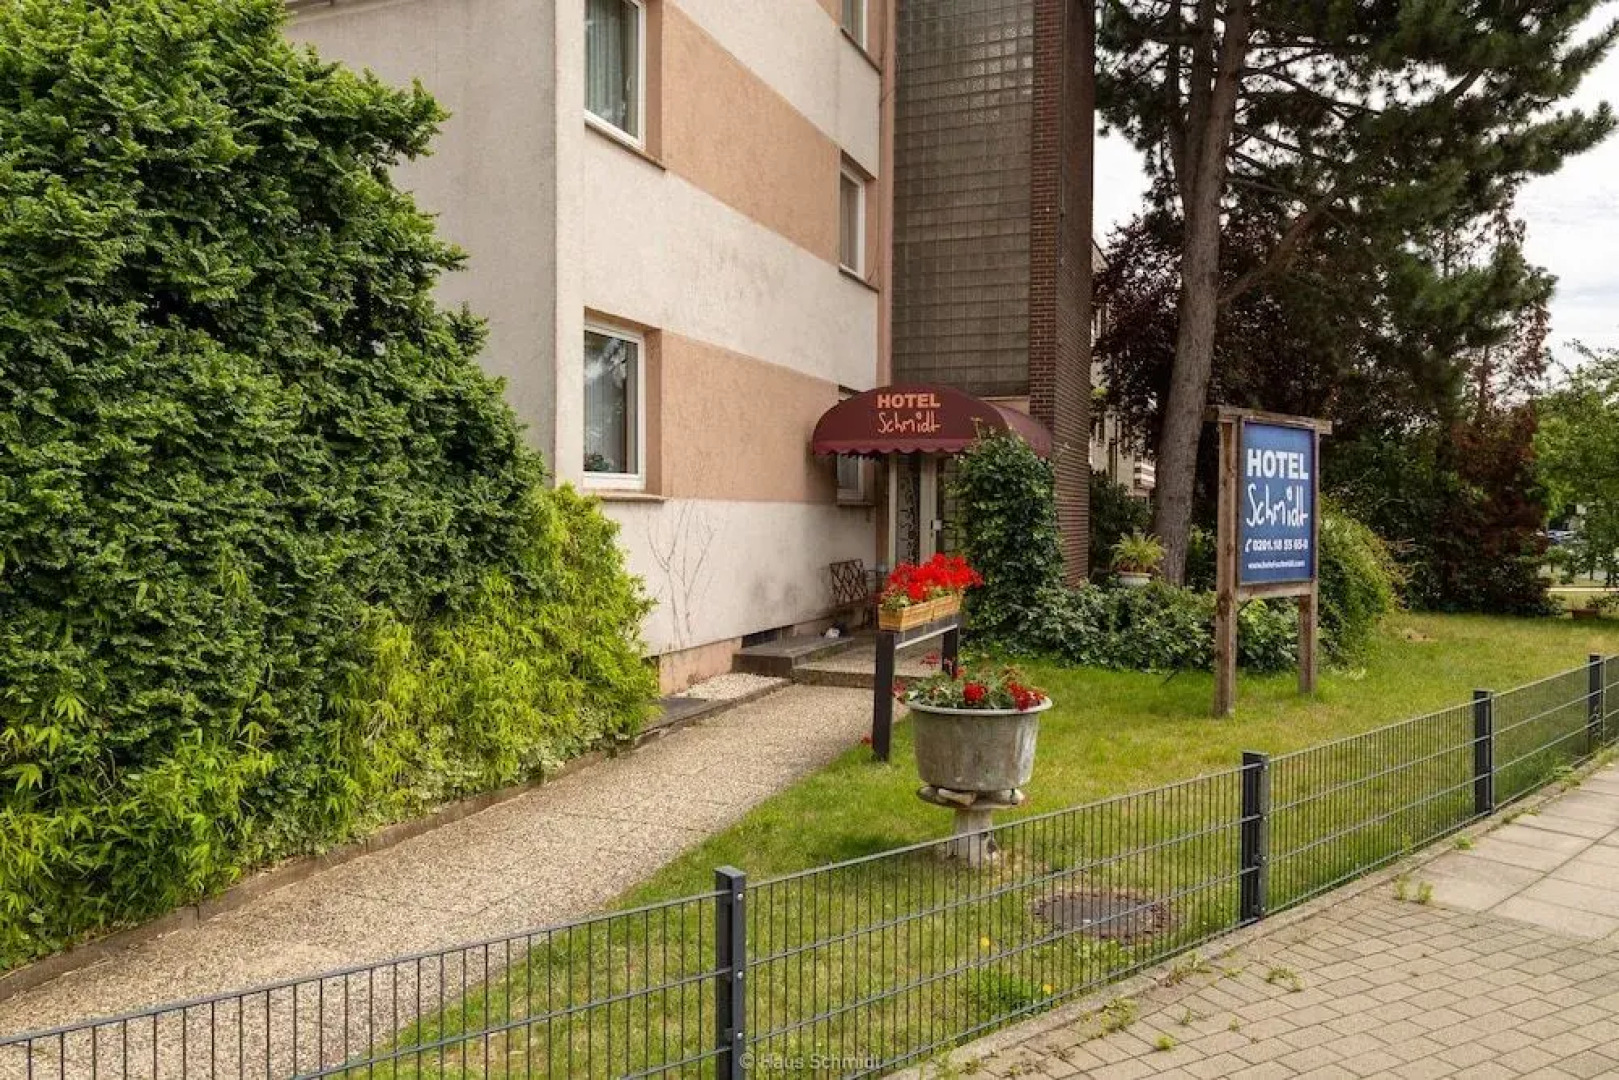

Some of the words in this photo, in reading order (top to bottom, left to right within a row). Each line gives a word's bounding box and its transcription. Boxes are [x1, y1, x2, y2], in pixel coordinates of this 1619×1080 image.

[877, 393, 941, 409] HOTEL
[877, 411, 942, 435] Schmidt
[1247, 448, 1308, 479] HOTEL
[1246, 483, 1308, 527] Schmidt
